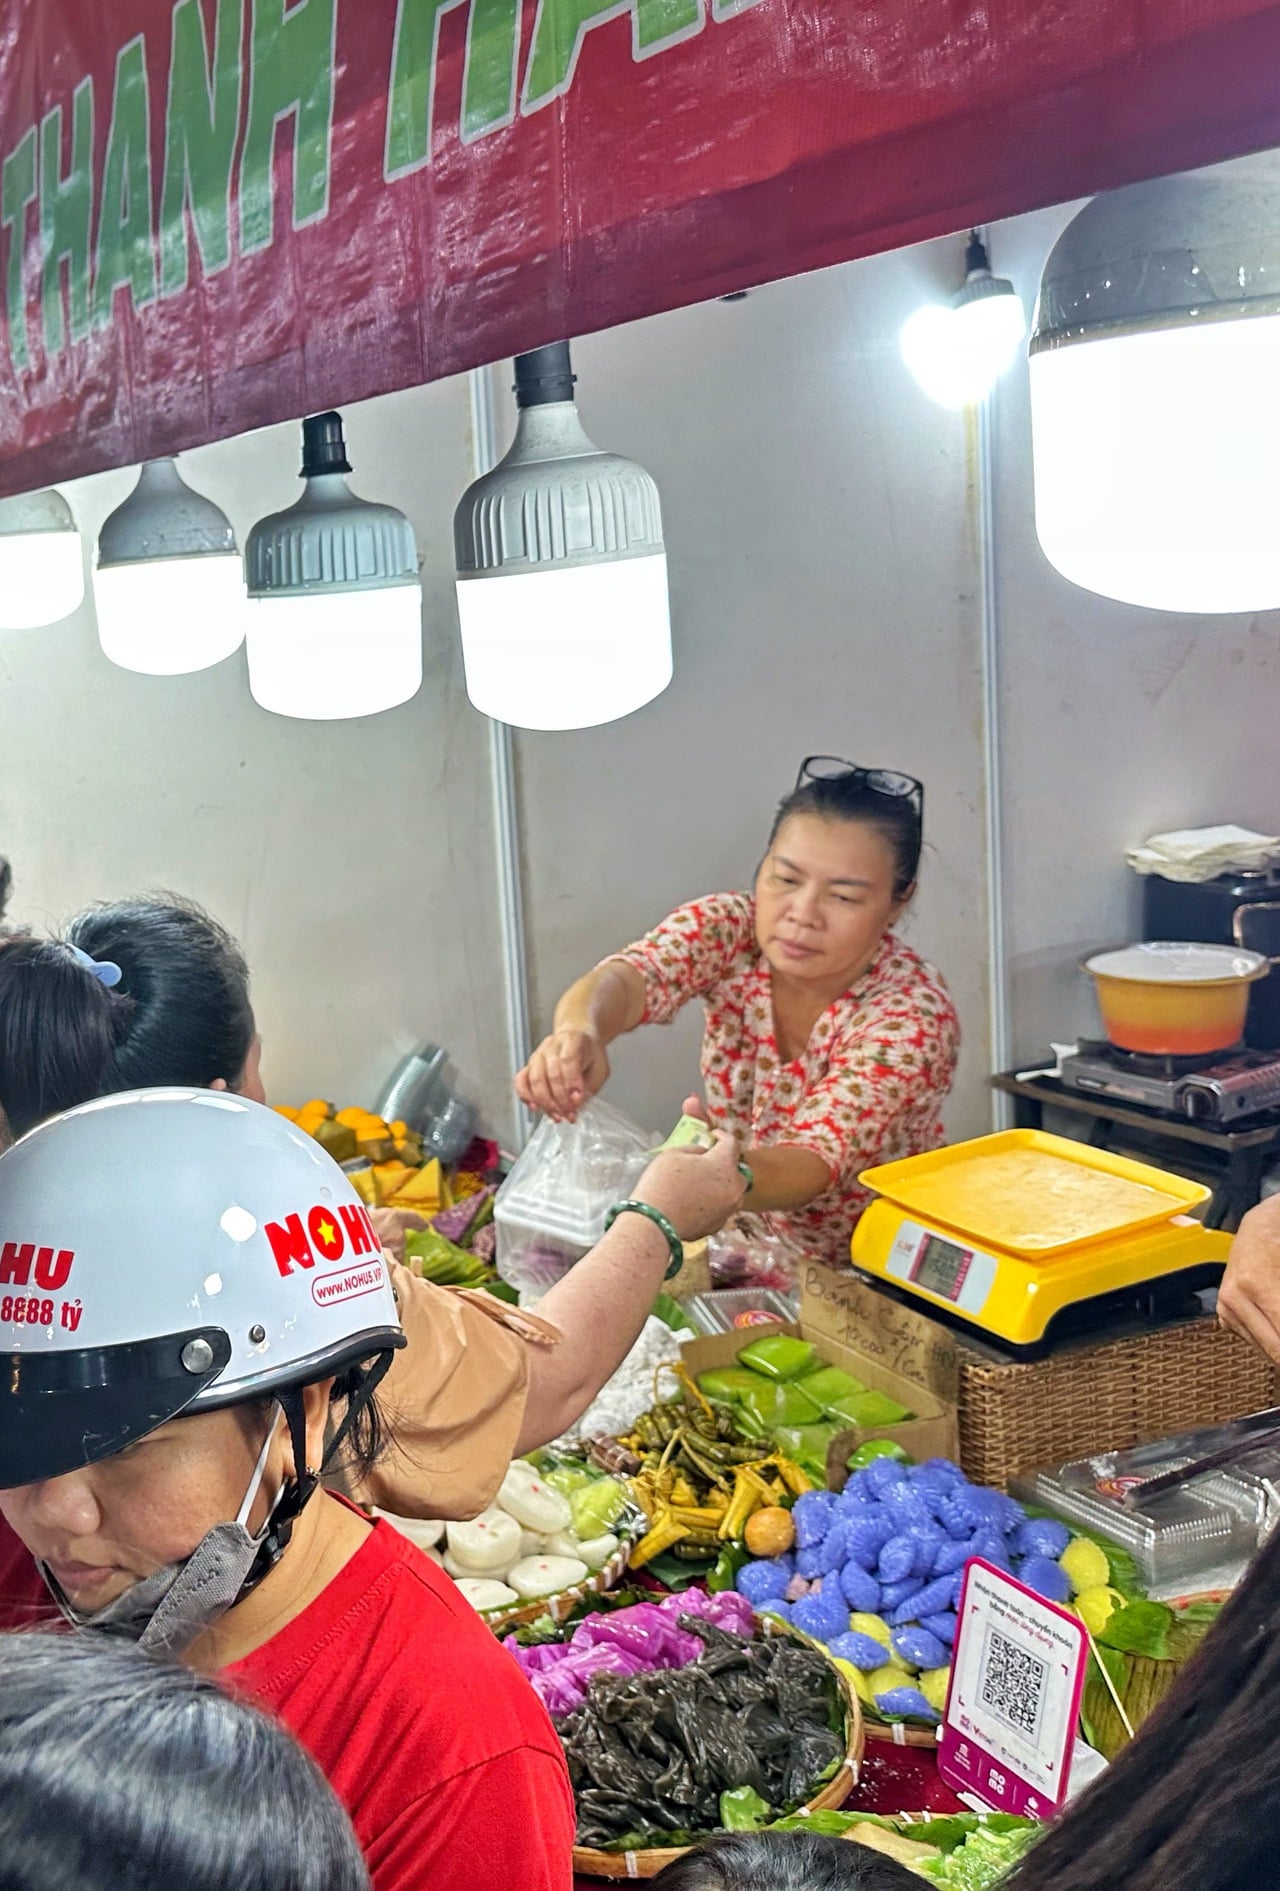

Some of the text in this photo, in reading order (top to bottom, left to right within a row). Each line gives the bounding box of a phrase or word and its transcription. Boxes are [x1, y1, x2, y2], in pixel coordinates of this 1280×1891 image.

[1, 0, 337, 373] THANH
[0, 1296, 55, 1326] 8888
[61, 1299, 83, 1332] tỷ
